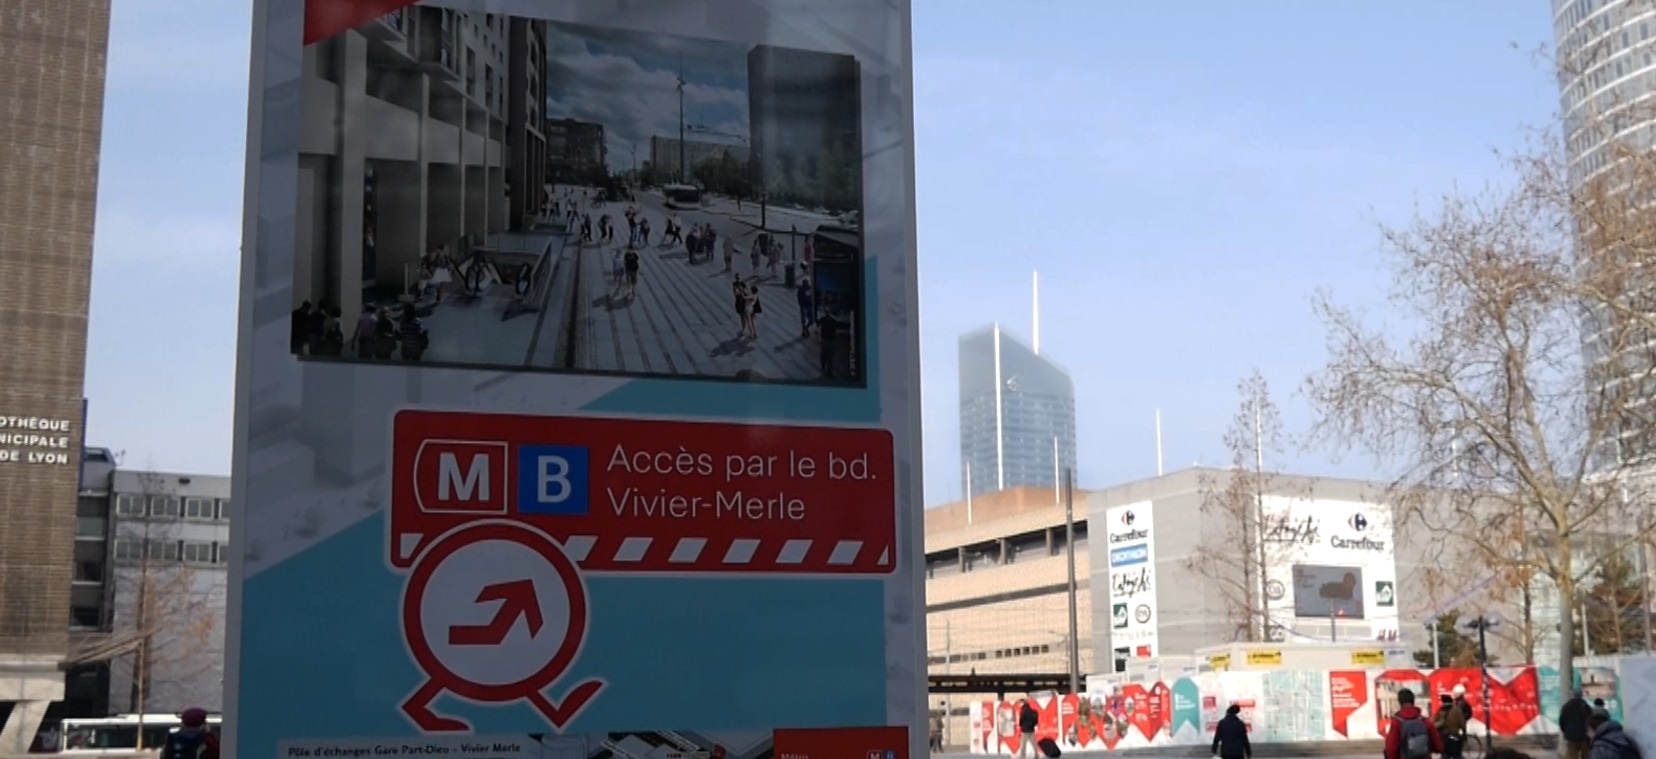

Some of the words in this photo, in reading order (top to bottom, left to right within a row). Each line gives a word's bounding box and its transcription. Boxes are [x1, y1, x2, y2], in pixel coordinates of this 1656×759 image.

[28, 451, 68, 464] LYON
[606, 444, 713, 476] Accès
[726, 452, 778, 482] par
[790, 449, 816, 479] le
[828, 451, 877, 480] bd.
[437, 452, 490, 502] M
[537, 455, 573, 503] B
[606, 487, 806, 521] Vivier-Merle
[1109, 529, 1149, 543] Carrefour
[1330, 535, 1385, 550] Carrefour
[374, 745, 398, 755] Gare
[401, 744, 449, 755] Part-Dieu
[460, 743, 489, 753] Vivier
[492, 743, 521, 753] Merle
